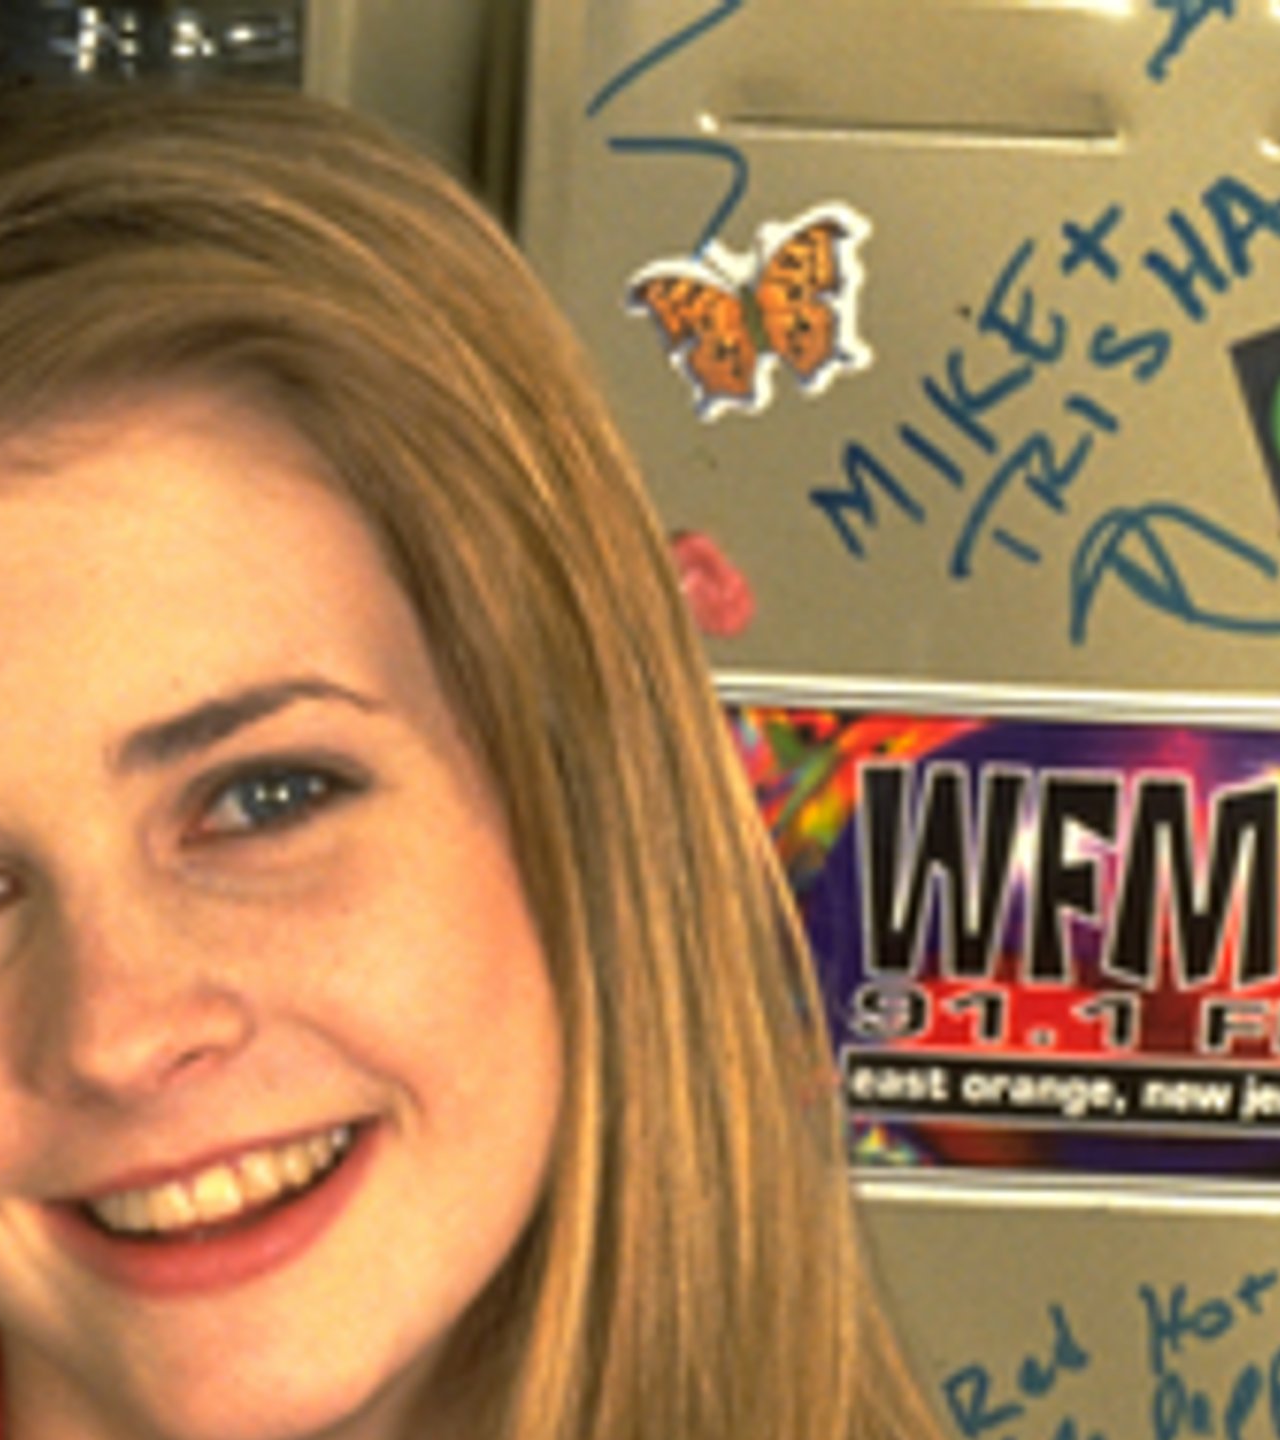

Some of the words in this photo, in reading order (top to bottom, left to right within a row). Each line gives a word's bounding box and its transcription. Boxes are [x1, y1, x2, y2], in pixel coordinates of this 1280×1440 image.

[851, 984, 1141, 1049] 91.1
[850, 1066, 949, 1099] east
[960, 1068, 1127, 1116] orange,
[1141, 1077, 1233, 1112] new
[941, 1303, 1089, 1440] Red
